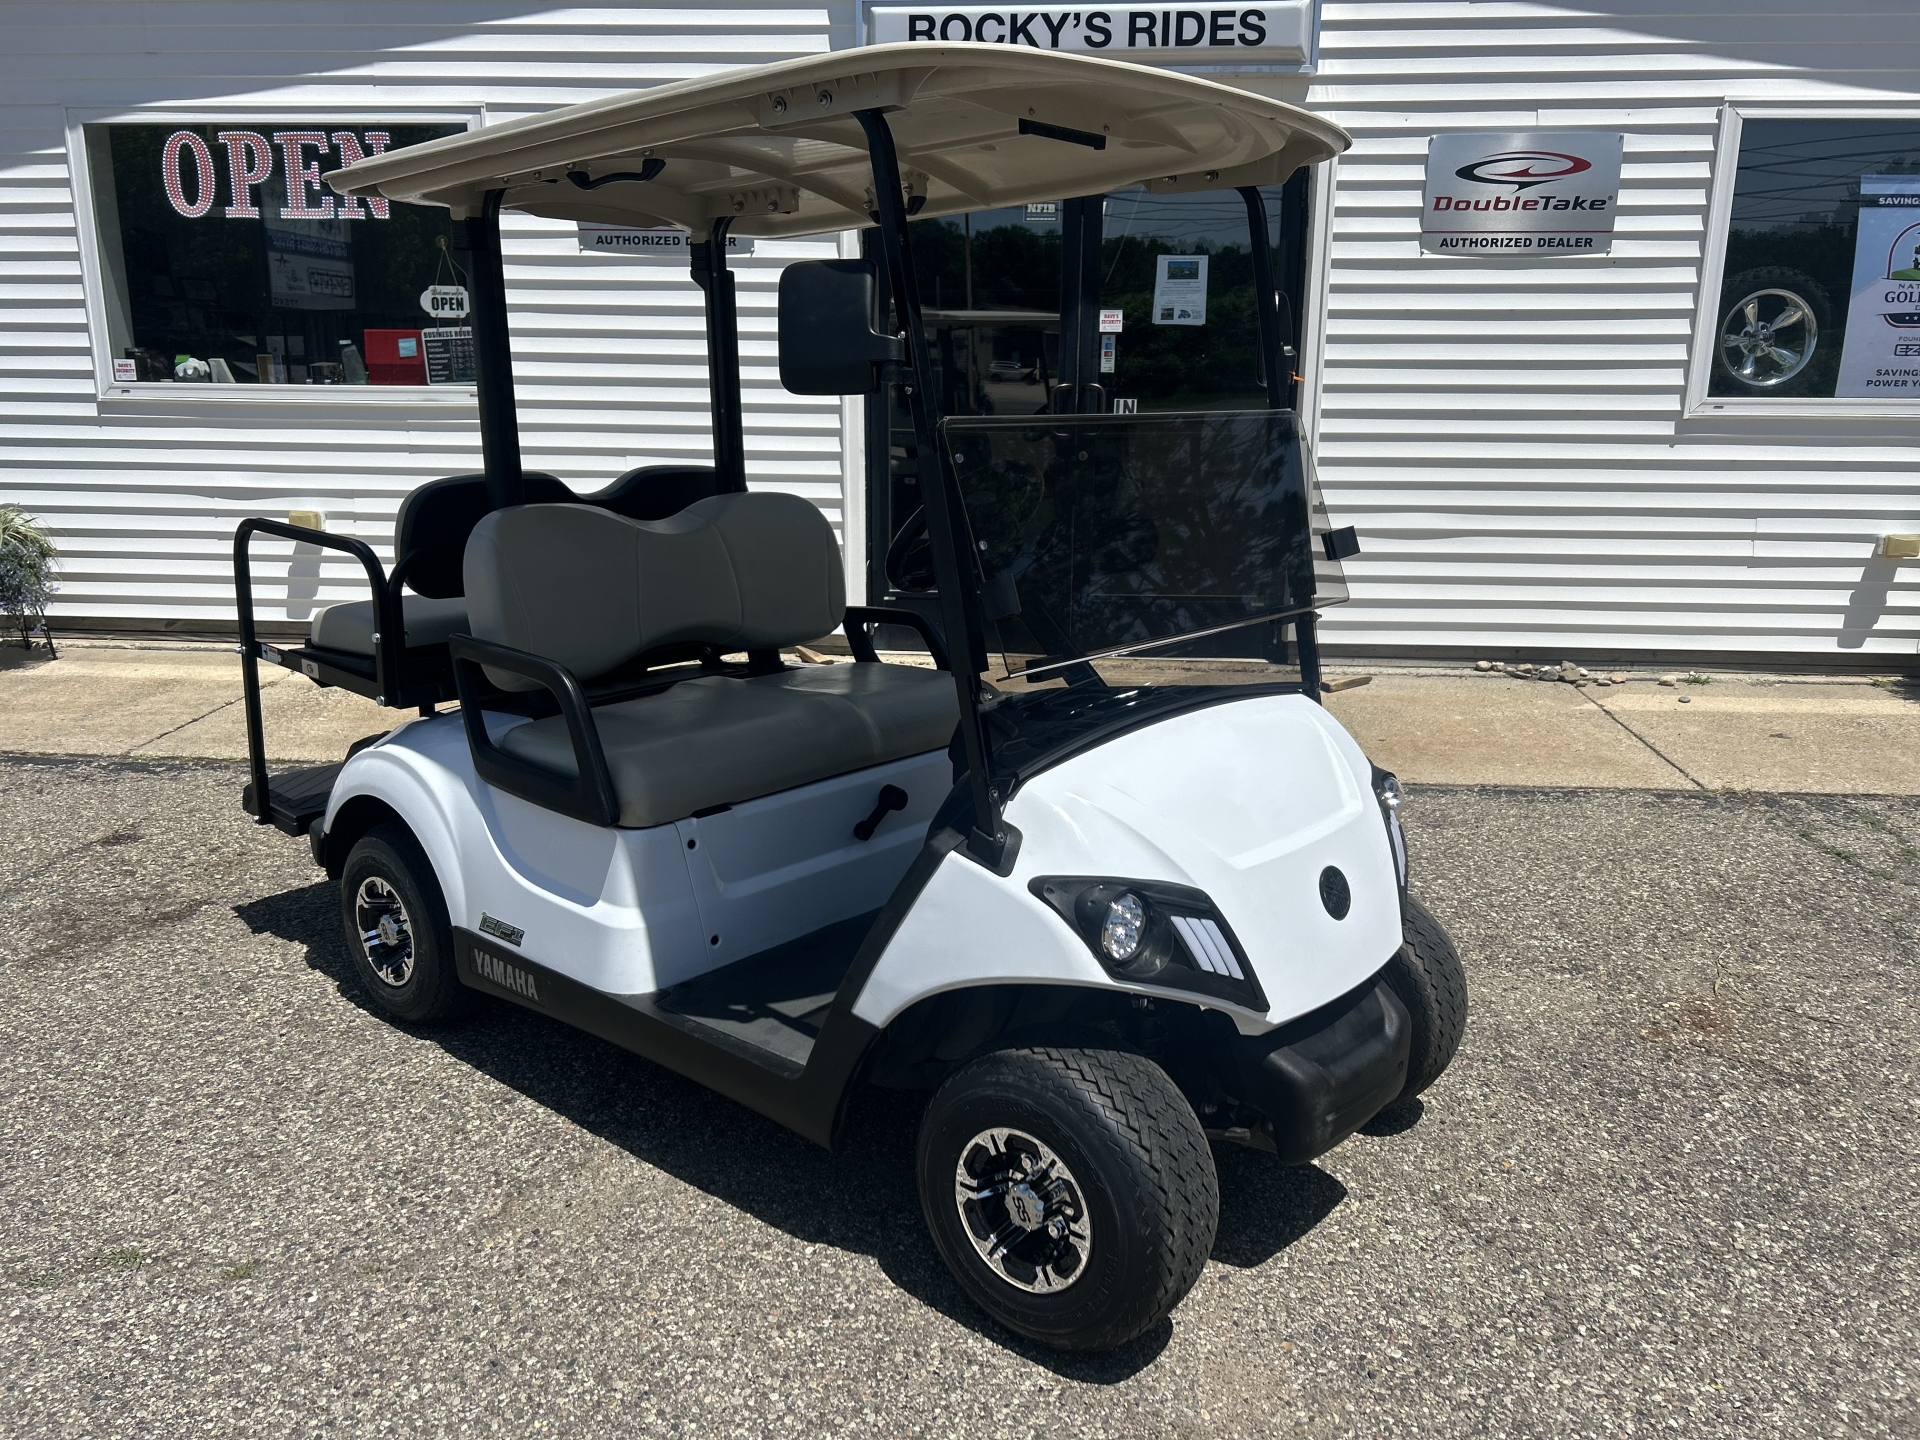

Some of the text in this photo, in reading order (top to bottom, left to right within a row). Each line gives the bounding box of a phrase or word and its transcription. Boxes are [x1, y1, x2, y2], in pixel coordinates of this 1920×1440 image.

[908, 9, 1267, 48] ROCKY'S RIDES
[163, 130, 390, 219] OPEN
[1878, 197, 1920, 205] SAVING
[1027, 204, 1056, 212] NFIB
[596, 236, 681, 246] AUTHORIZED
[1439, 238, 1594, 248] AUTHORIZED DEALER
[431, 297, 464, 311] OPEN
[474, 948, 539, 1000] YAMAHA
